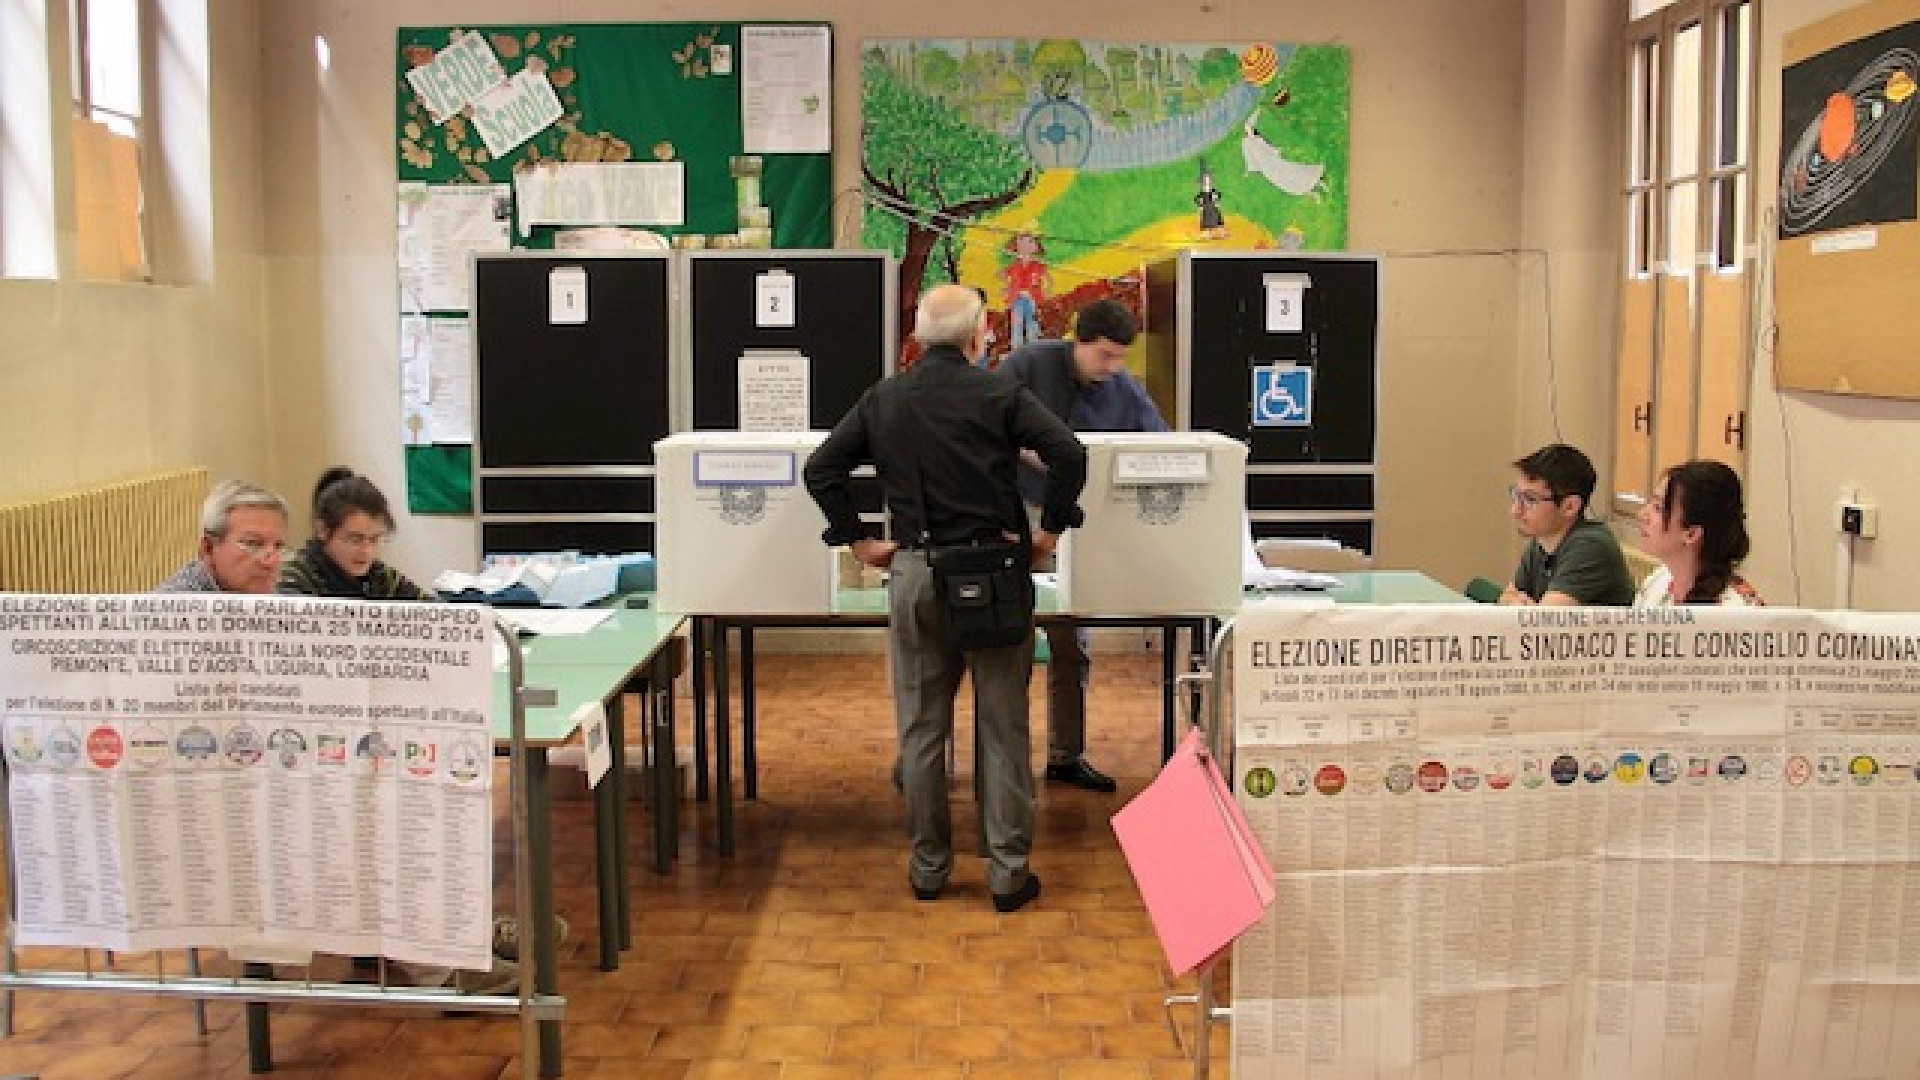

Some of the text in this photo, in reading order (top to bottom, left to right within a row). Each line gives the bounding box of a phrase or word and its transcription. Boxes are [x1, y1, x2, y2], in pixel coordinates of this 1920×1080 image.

[416, 38, 498, 114] VERDE
[477, 78, 557, 149] Scuola
[565, 292, 574, 308] 1
[769, 296, 780, 313] 2
[1280, 299, 1291, 316] 3
[2, 599, 481, 625] ELEZIONE DEI MEMBRI DEL PARLAMENTO EUROPEO
[1518, 610, 1588, 628] COMUNE
[0, 615, 484, 643] SPETTANTI ALL'ITALIA DI DOMENICA 25 MAGGIO 2014
[12, 638, 138, 655] CIRCOSCRIZIONE
[143, 639, 244, 655] ELETTORALE
[258, 641, 307, 658] ITALIA
[311, 644, 358, 661] NORD
[361, 645, 472, 667] OCCIDENTALE
[1252, 632, 1920, 667] ELEZIONE DIRETTA DEL SINDACO E DEL CONSIGLIO COMUNA
[138, 657, 184, 674] VALLE
[336, 663, 431, 682] LOMBARDIA
